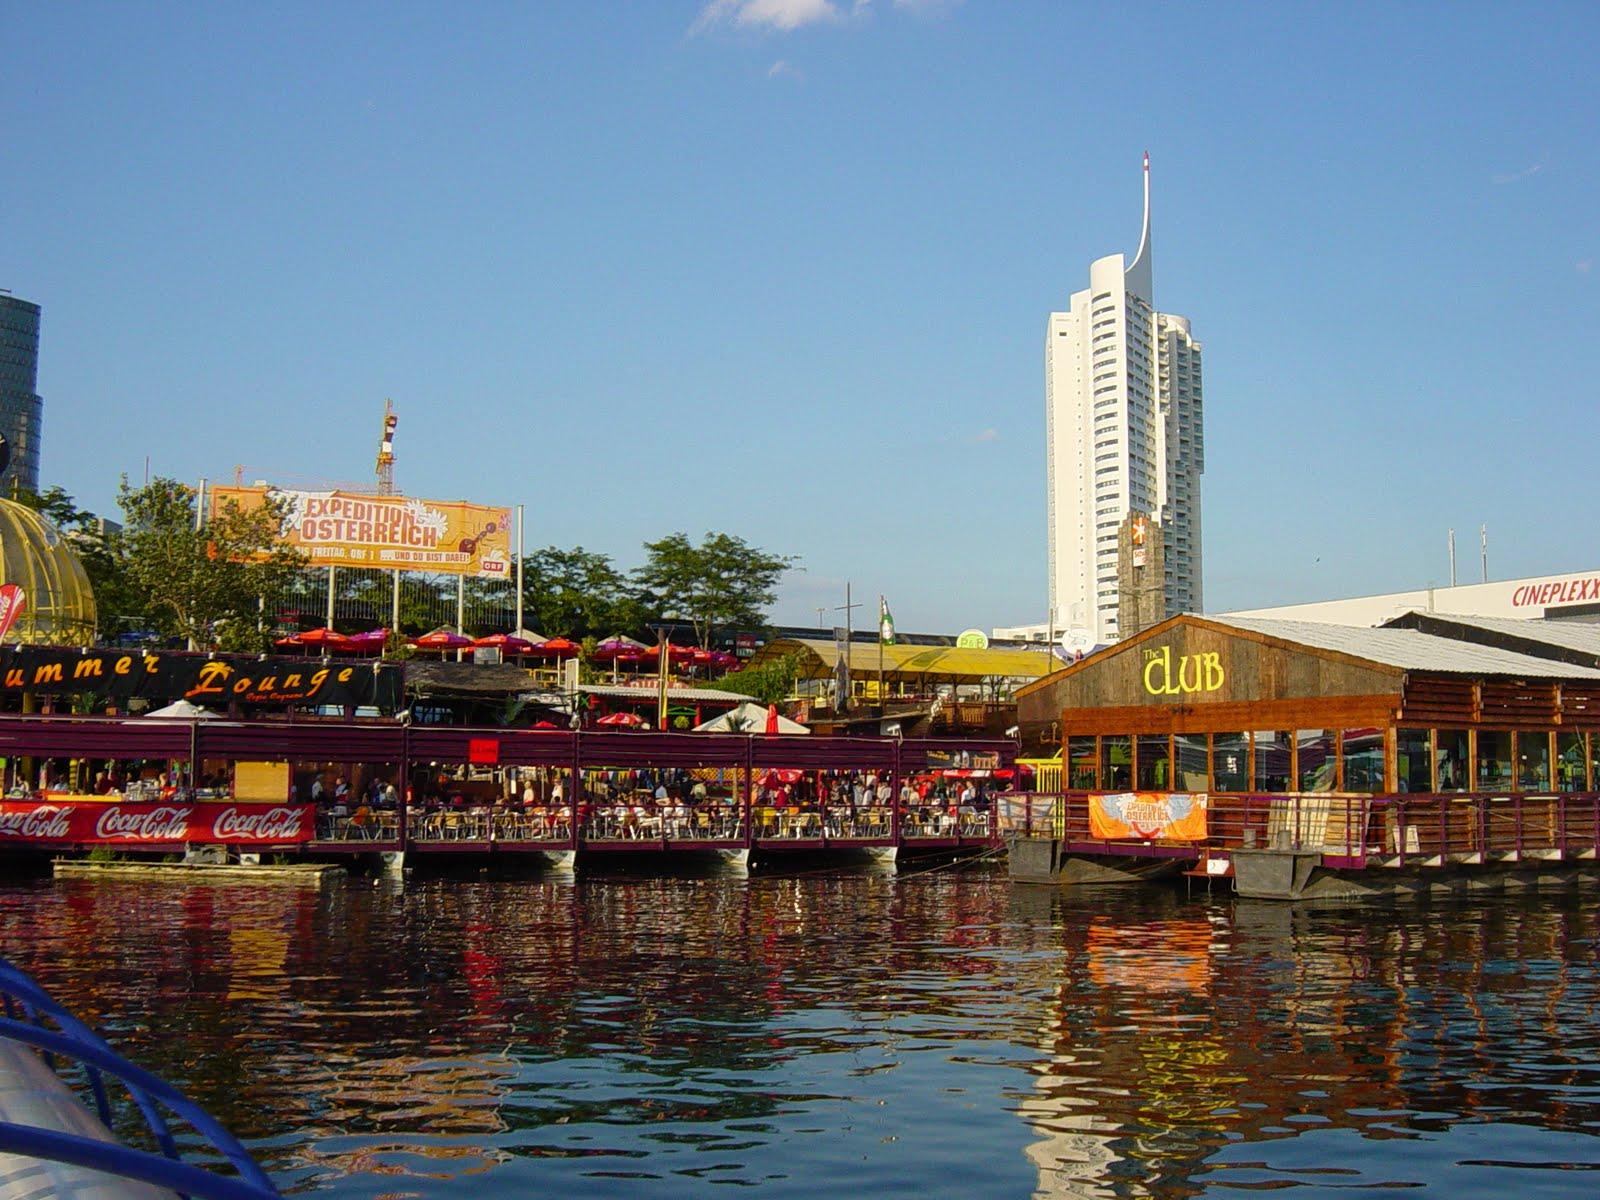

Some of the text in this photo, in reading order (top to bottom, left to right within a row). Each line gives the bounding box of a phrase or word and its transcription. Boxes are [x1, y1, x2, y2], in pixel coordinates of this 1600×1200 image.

[304, 497, 415, 525] EXPEDITION
[412, 551, 424, 562] DU
[426, 552, 443, 563] BIST
[445, 553, 470, 564] DABEI!
[484, 561, 504, 571] ORF
[1512, 578, 1600, 607] CINEPLEXX
[1142, 648, 1160, 660] The
[0, 654, 354, 698] ummer Lounge
[96, 806, 195, 839] Coca-Cola
[213, 807, 306, 839] Coca-Cola
